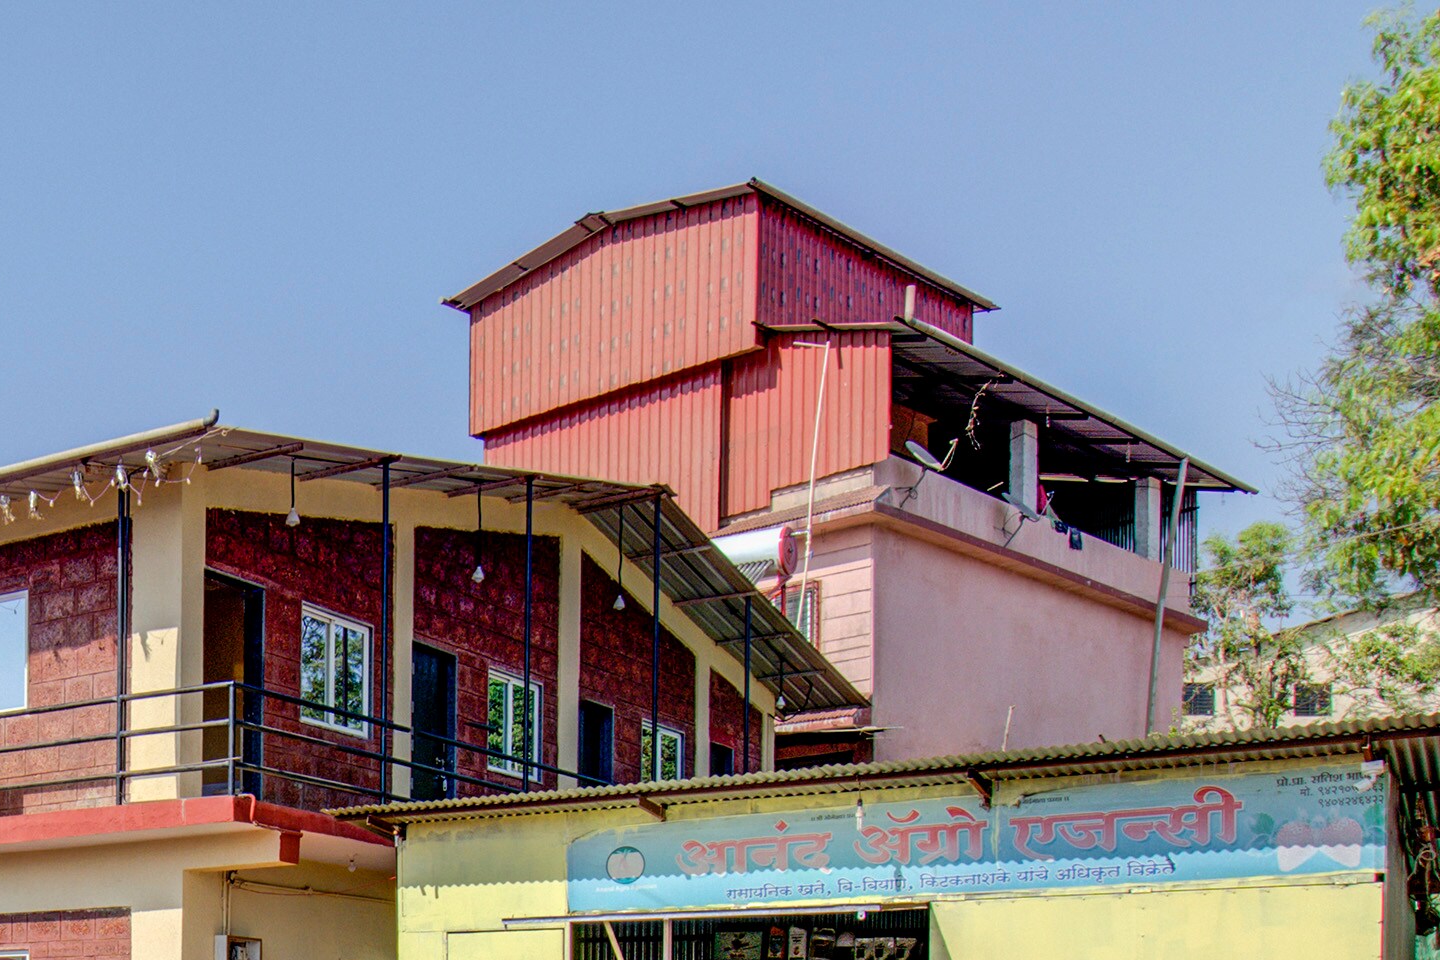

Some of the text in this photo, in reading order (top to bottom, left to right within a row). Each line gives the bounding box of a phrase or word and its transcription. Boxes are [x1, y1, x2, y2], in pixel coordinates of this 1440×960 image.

[674, 819, 833, 876] आनंद
[1010, 786, 1242, 863] एजन्सी
[1017, 865, 1049, 882] यांचे
[1055, 864, 1121, 884] अधिकृत
